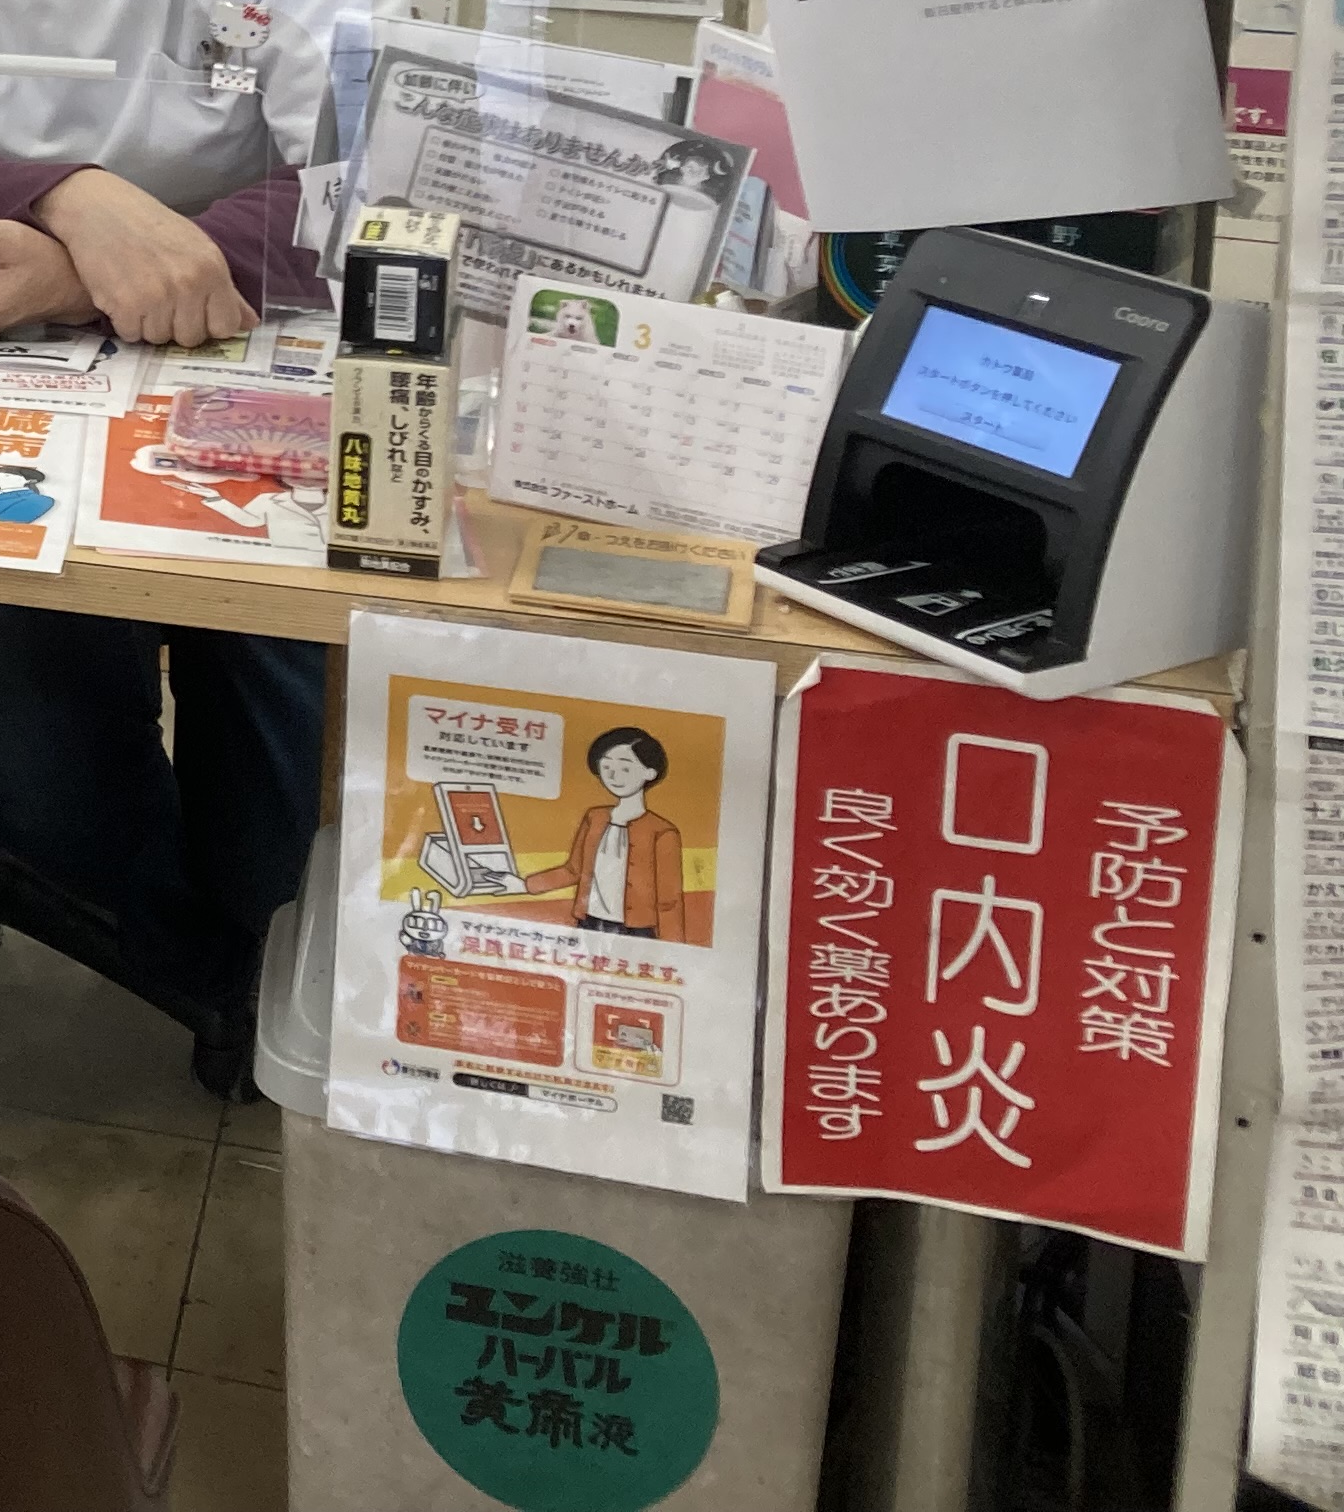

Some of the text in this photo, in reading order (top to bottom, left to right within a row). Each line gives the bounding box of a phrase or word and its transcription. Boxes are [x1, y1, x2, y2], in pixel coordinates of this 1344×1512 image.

[633, 323, 652, 351] 3
[423, 706, 548, 741] マイナ受付
[803, 787, 899, 1142] 良く効く薬あります
[913, 731, 1050, 1170] 口内炎
[1078, 799, 1189, 1068] 予防と対策
